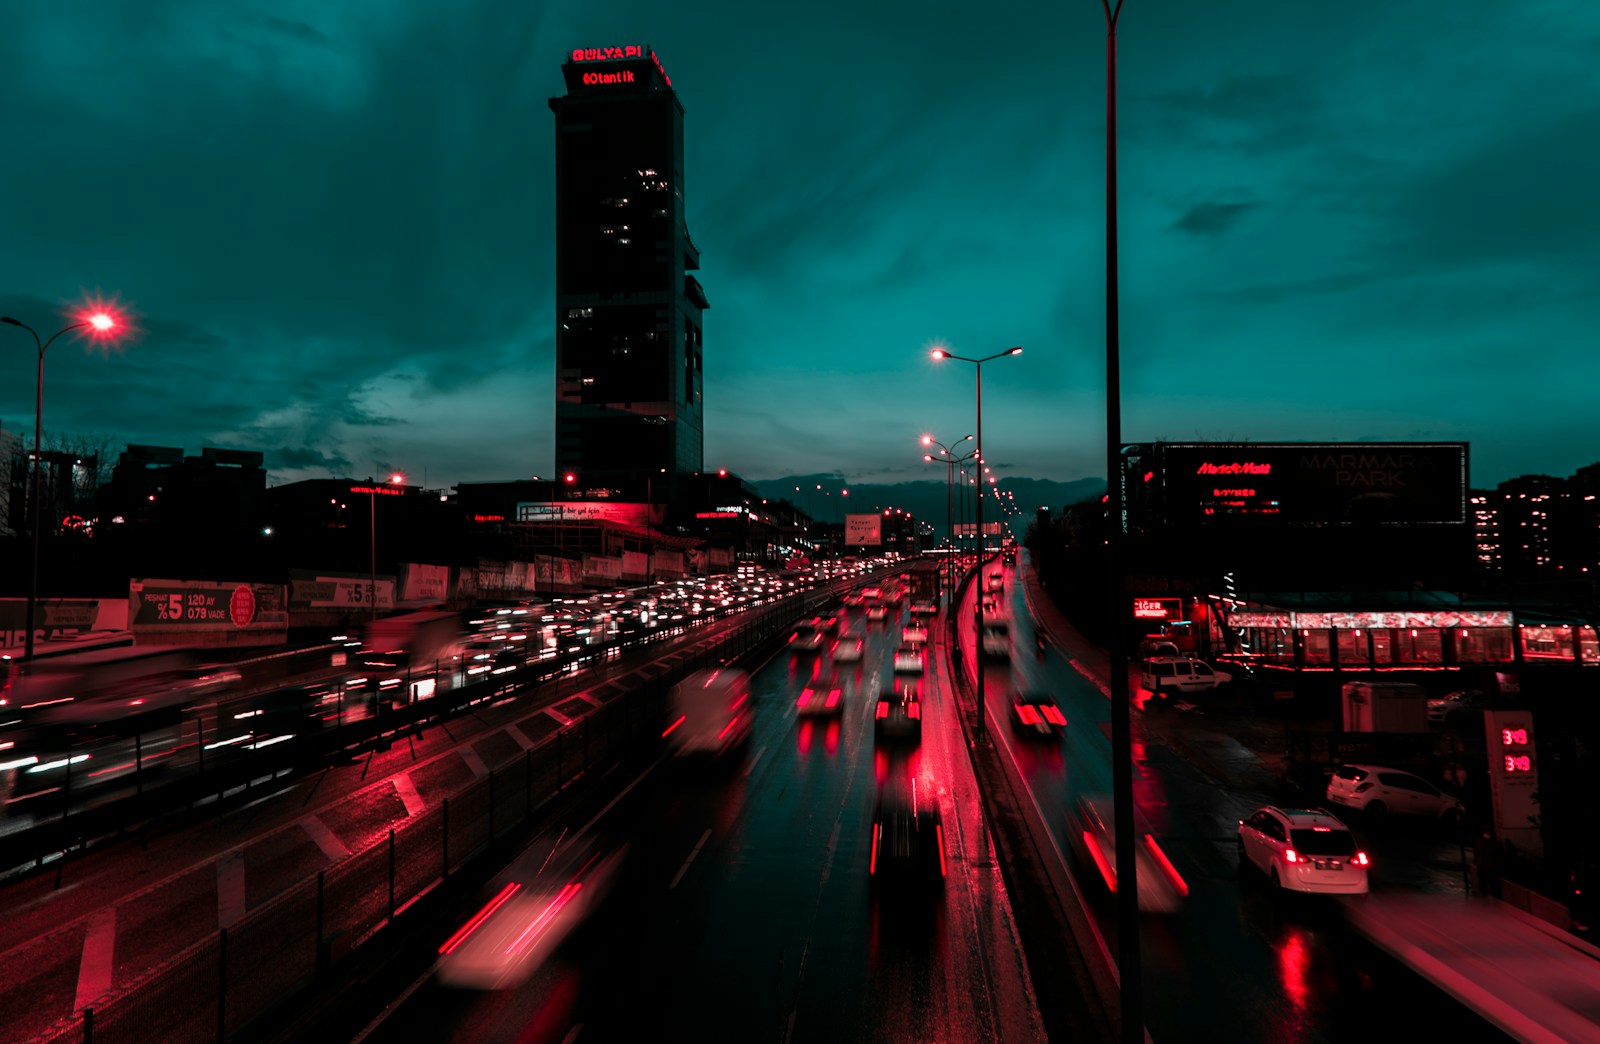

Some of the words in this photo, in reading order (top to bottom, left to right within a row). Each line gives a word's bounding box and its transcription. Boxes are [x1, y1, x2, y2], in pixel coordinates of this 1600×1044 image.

[1299, 454, 1436, 469] MARMARA
[1335, 470, 1406, 487] PARK
[187, 593, 206, 606] 120
[206, 597, 216, 606] AY
[208, 610, 226, 620] VADE
